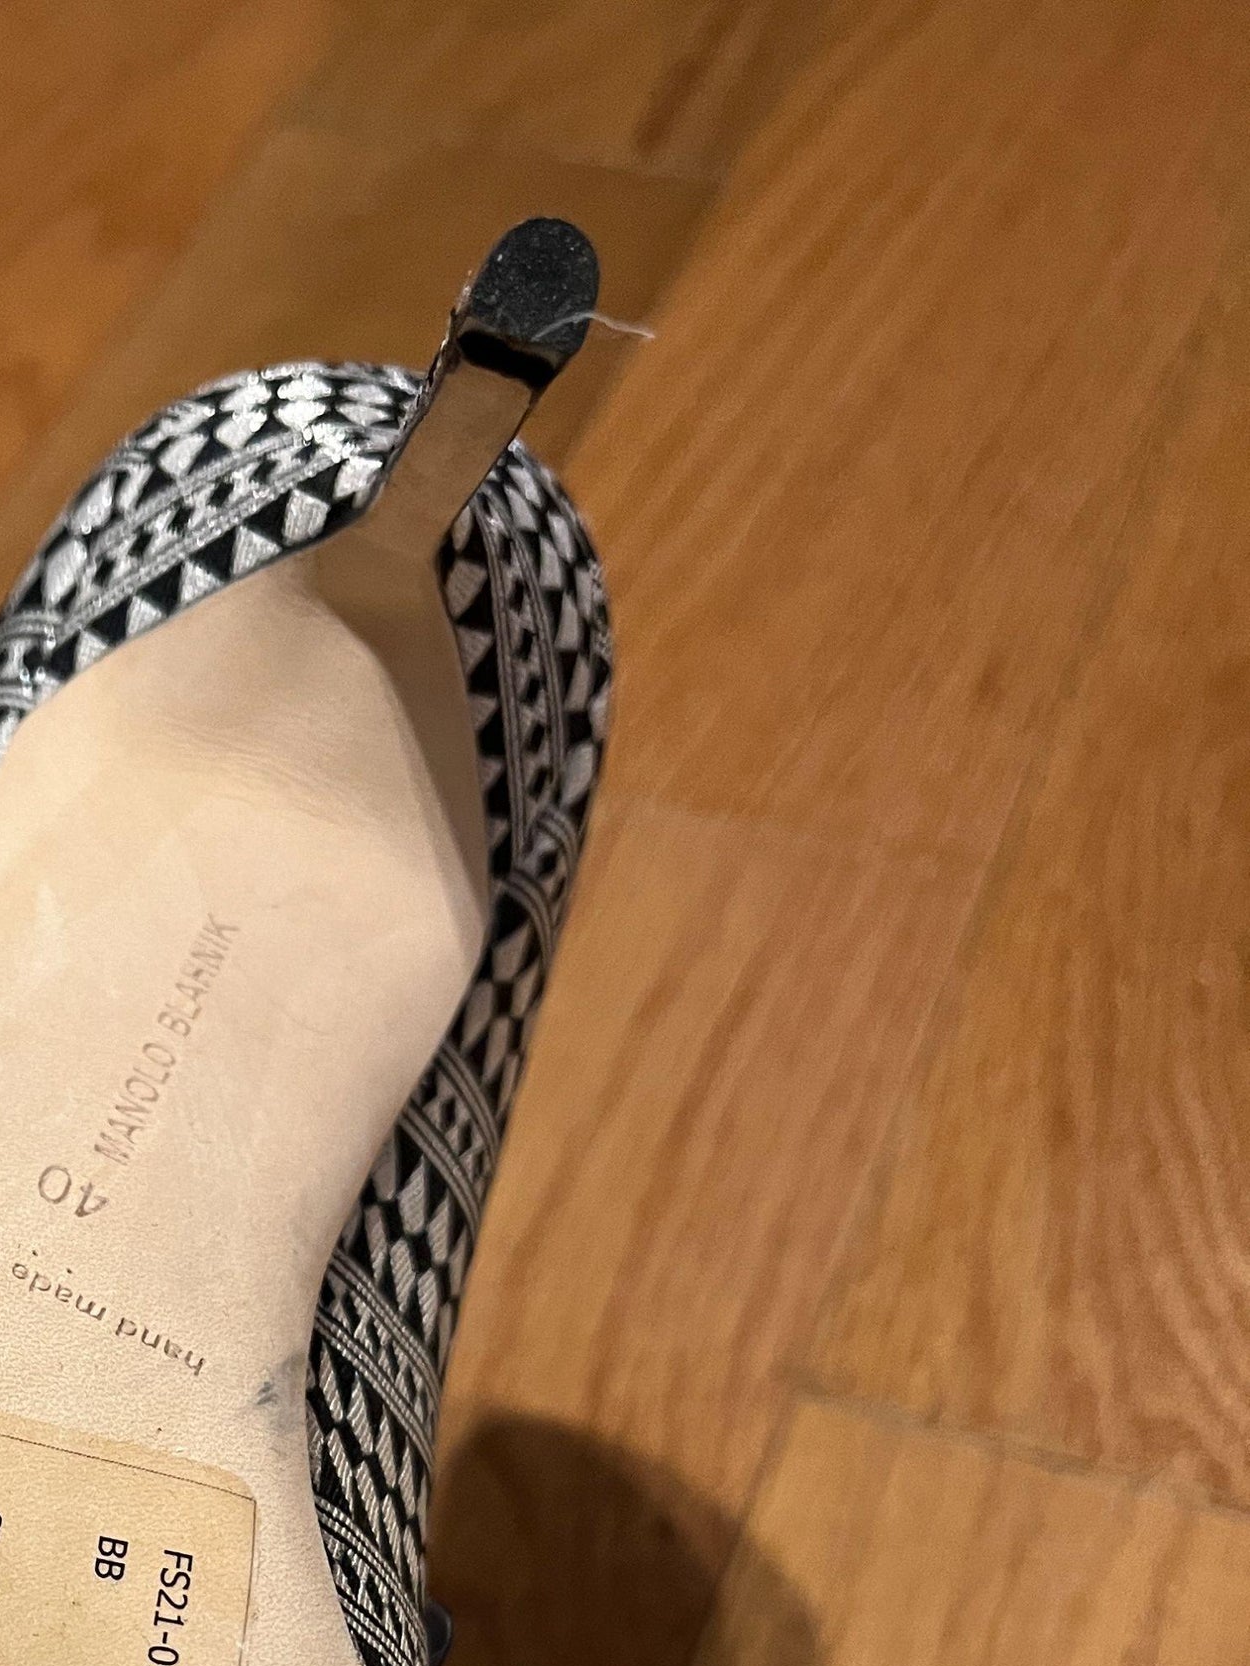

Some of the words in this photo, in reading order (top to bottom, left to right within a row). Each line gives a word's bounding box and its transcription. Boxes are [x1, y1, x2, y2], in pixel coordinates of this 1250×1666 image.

[94, 1042, 177, 1167] MANOLO
[158, 912, 241, 1037] BLAHNIK
[37, 1164, 110, 1218] 40
[11, 1260, 106, 1322] made
[115, 1316, 206, 1376] hand
[94, 1534, 129, 1581] BB
